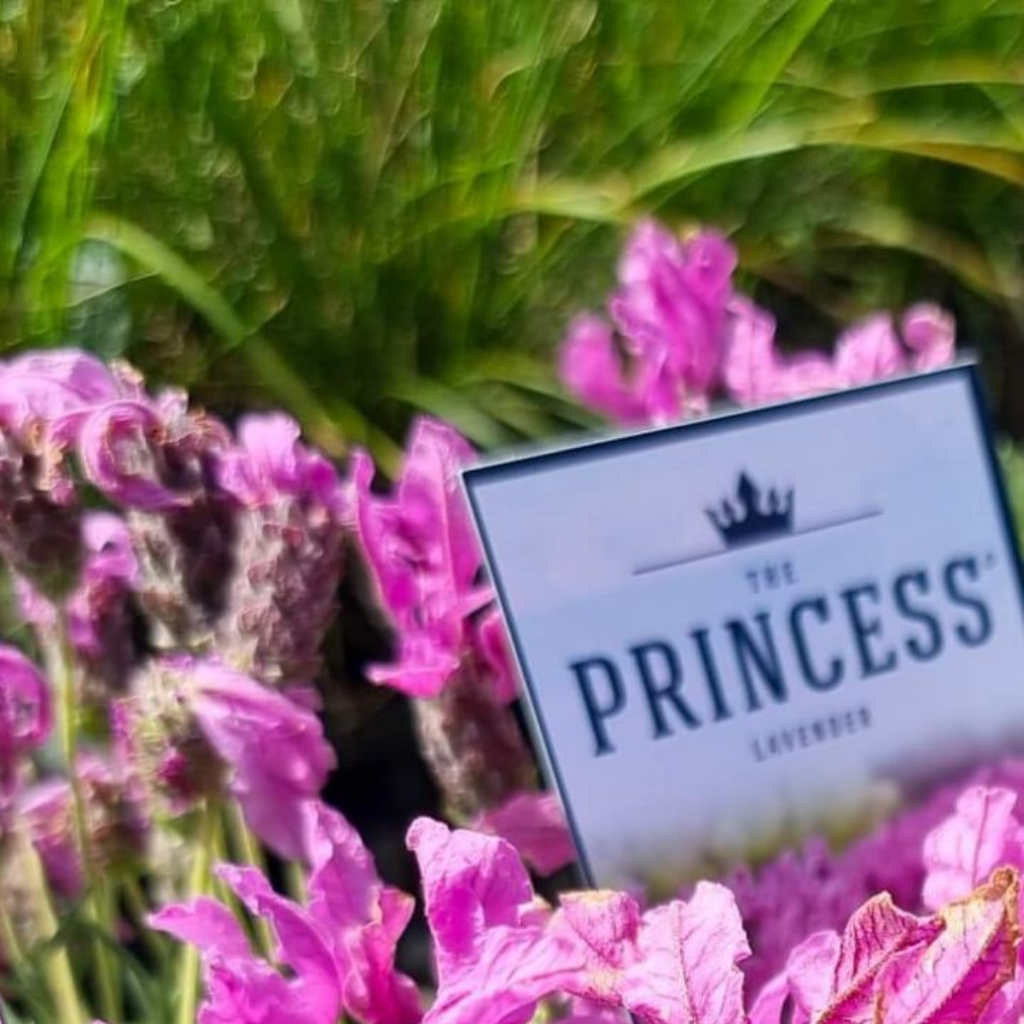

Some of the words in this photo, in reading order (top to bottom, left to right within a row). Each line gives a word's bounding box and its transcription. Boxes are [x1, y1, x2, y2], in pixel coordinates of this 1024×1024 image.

[746, 562, 796, 594] THE
[566, 556, 995, 758] PRINCESS
[751, 707, 872, 762] LAVENDER
